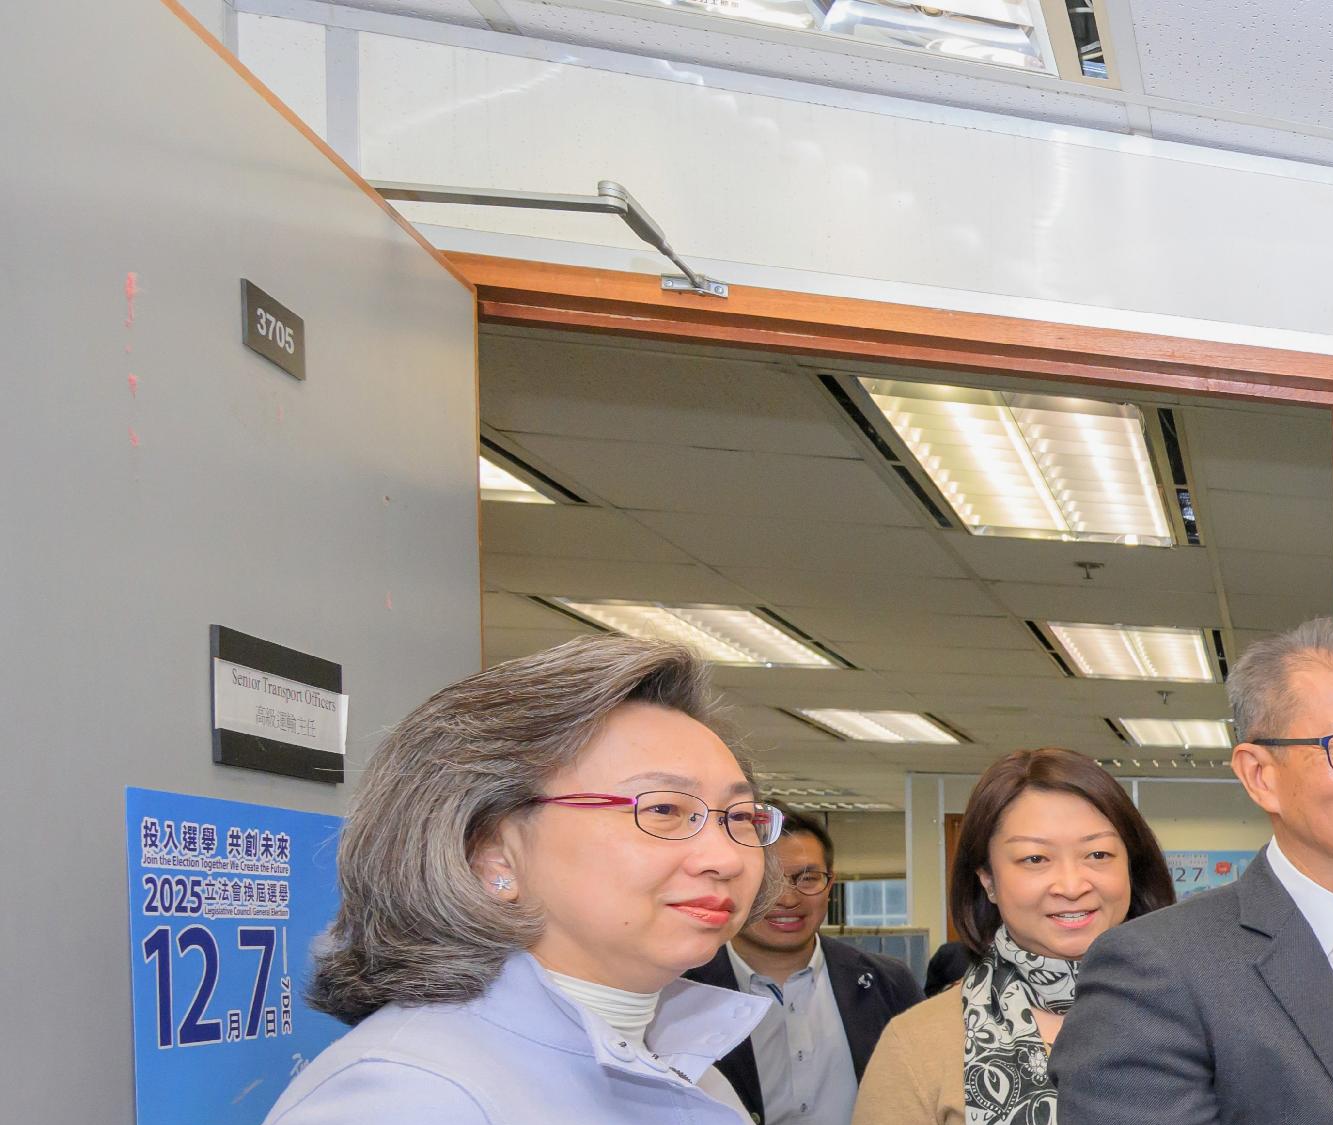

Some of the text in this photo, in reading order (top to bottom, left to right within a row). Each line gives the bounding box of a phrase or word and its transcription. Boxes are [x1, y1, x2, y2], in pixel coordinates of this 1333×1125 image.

[256, 307, 295, 354] 3705
[231, 668, 337, 712] Senior Transport Officers
[143, 819, 289, 860] 投入選舉 共創未來
[143, 854, 289, 875] Join the Election Together We Create the Future
[144, 876, 203, 914] 2025
[204, 907, 233, 918] Legislative
[281, 993, 291, 1034] DEC
